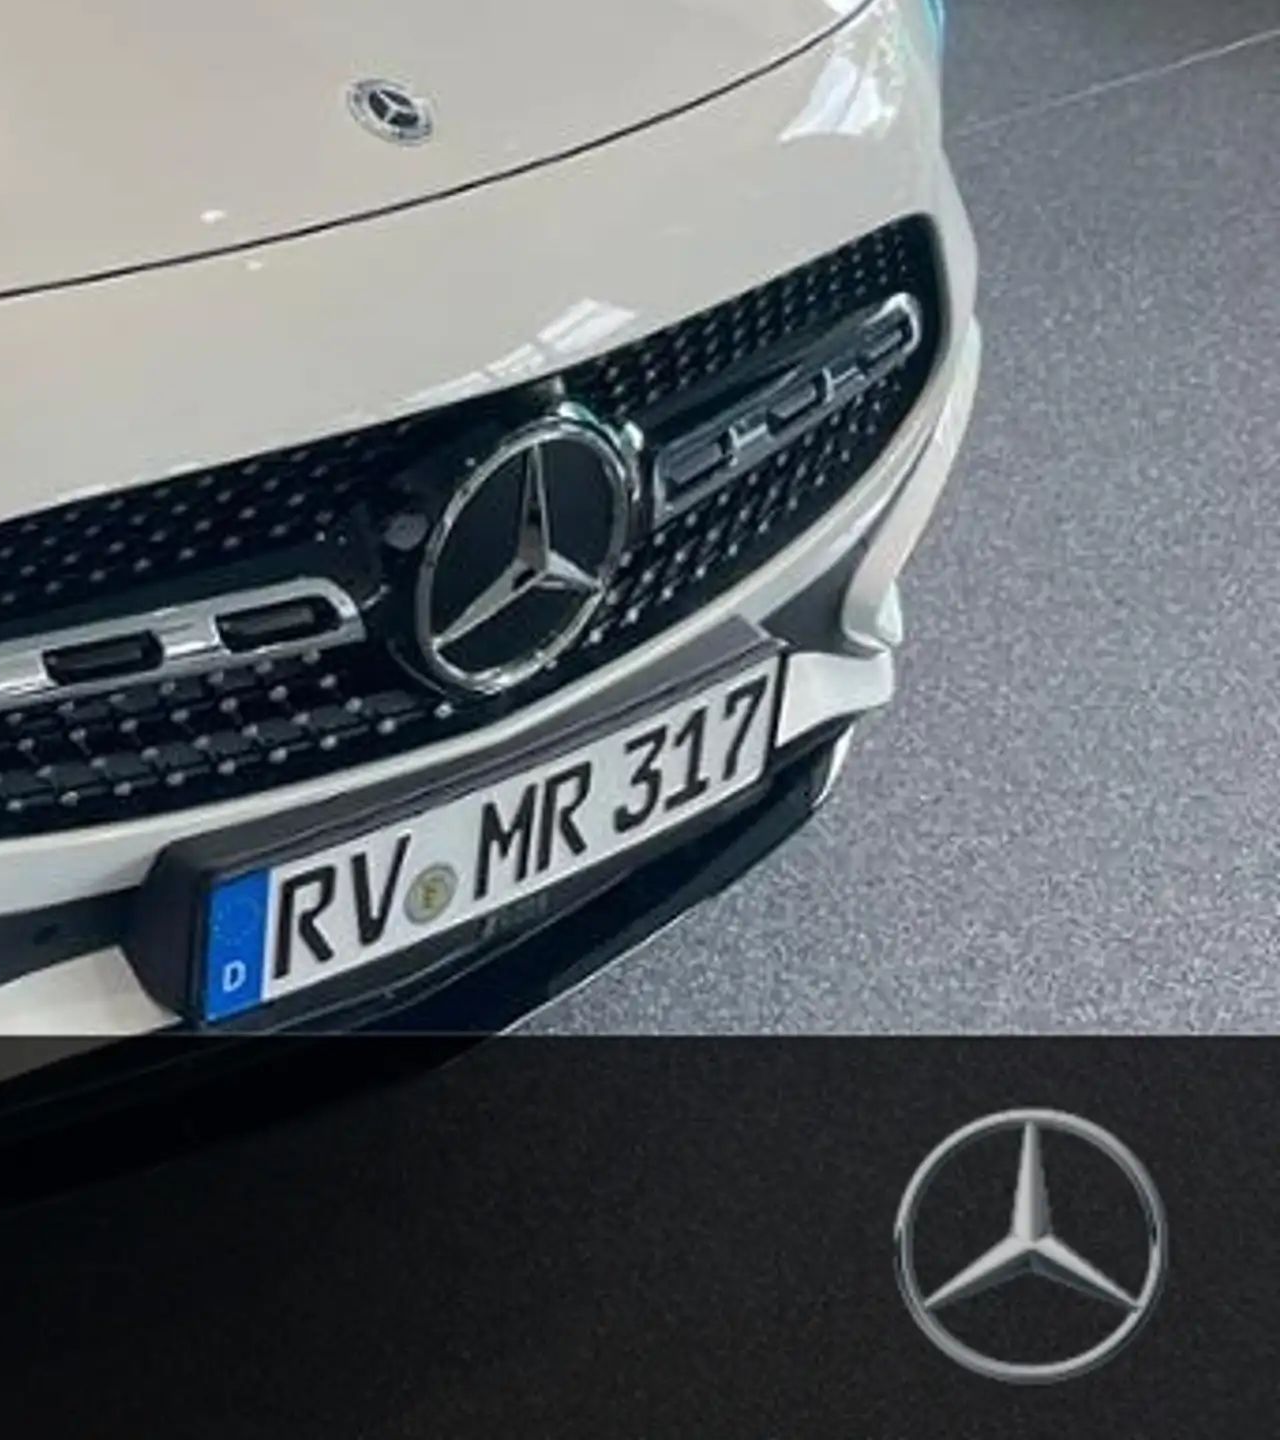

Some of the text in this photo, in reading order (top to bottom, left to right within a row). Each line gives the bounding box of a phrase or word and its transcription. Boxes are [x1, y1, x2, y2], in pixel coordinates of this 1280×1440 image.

[273, 674, 767, 981] RV MR 317
[222, 961, 246, 993] D
